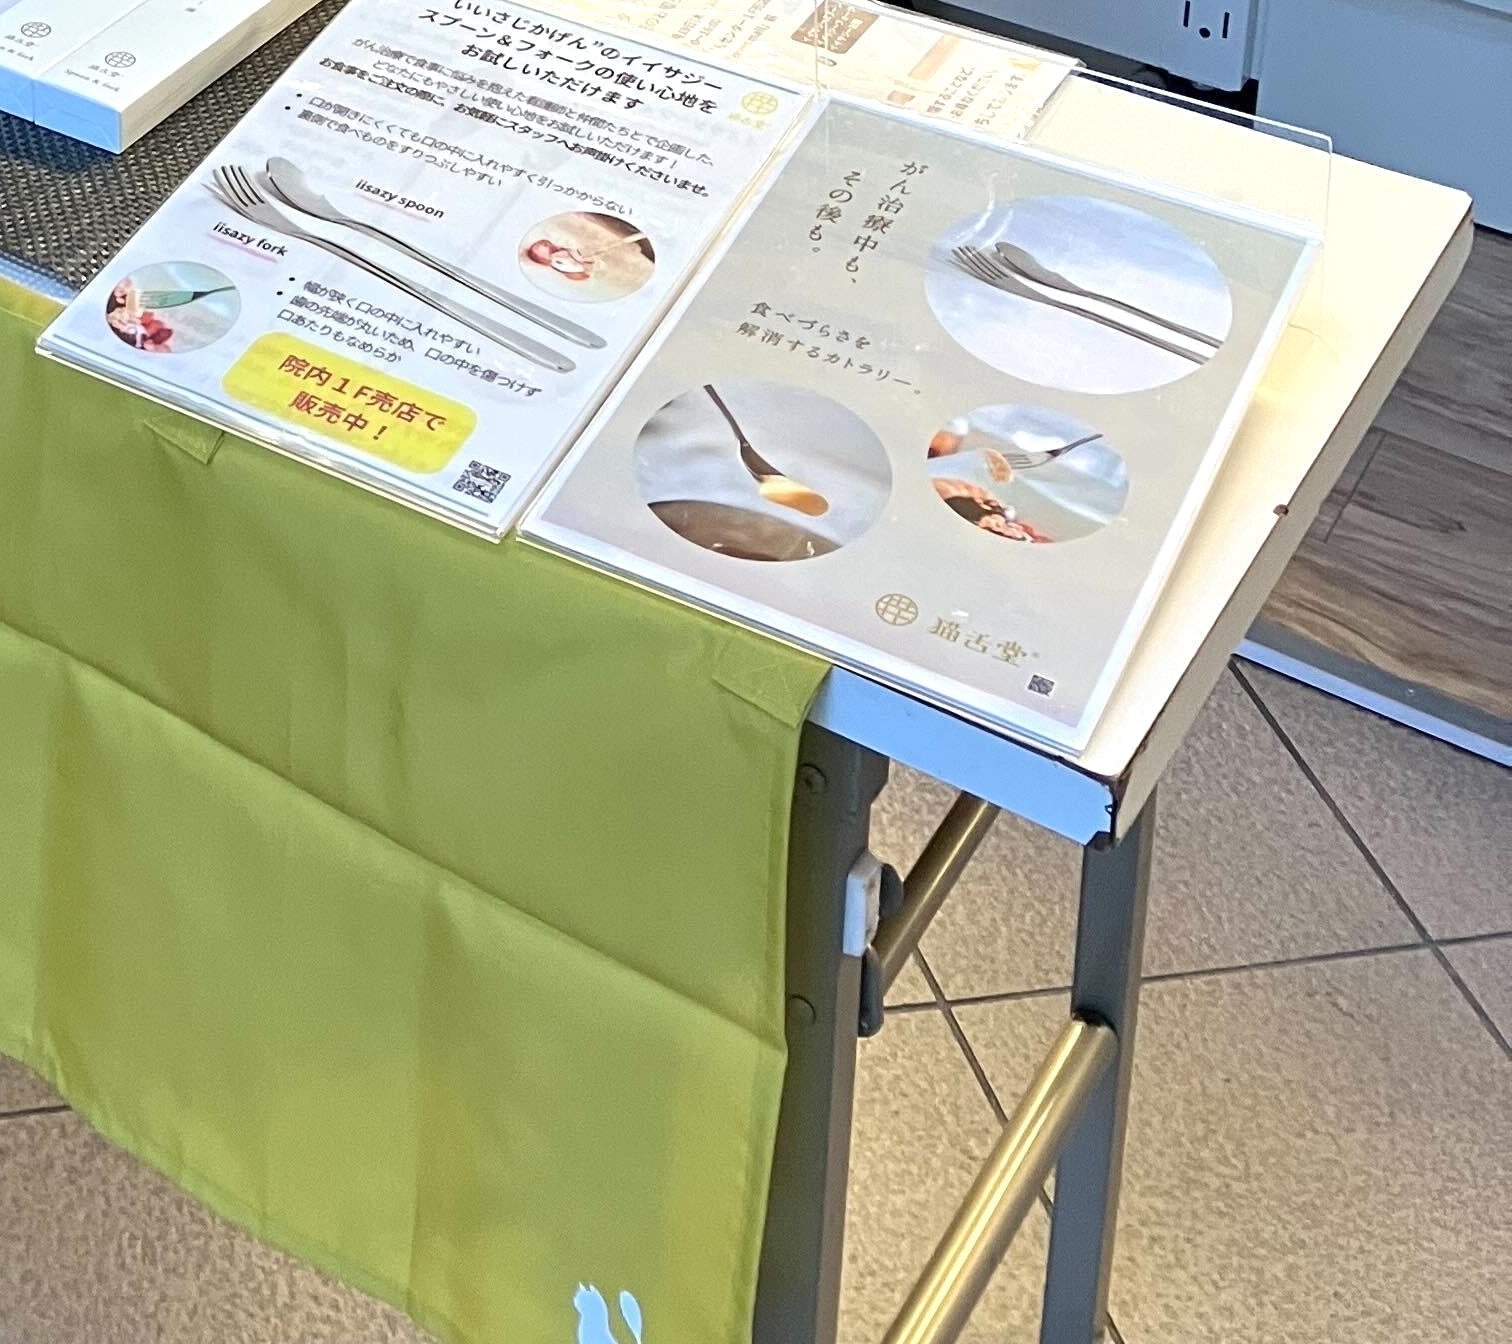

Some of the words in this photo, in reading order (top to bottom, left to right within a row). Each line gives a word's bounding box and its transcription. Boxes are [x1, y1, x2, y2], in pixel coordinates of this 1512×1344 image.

[418, 8, 719, 114] スプーン&フォークの使い心地を
[461, 44, 645, 111] お試しいただけます
[355, 178, 398, 202] iisazy
[398, 196, 444, 220] spoon
[808, 171, 862, 253] その後も。
[845, 161, 930, 284] がん治療中も、
[212, 221, 254, 248] iisazy
[256, 236, 288, 258] fork
[277, 308, 402, 364] 口あたりもなめらか
[751, 301, 872, 351] 食べづらさを
[736, 321, 921, 395] 解消するカトラリー。
[278, 354, 447, 432] 院内1F売店で
[289, 390, 388, 441] 販売中！
[928, 616, 1026, 668] 猫舌堂
